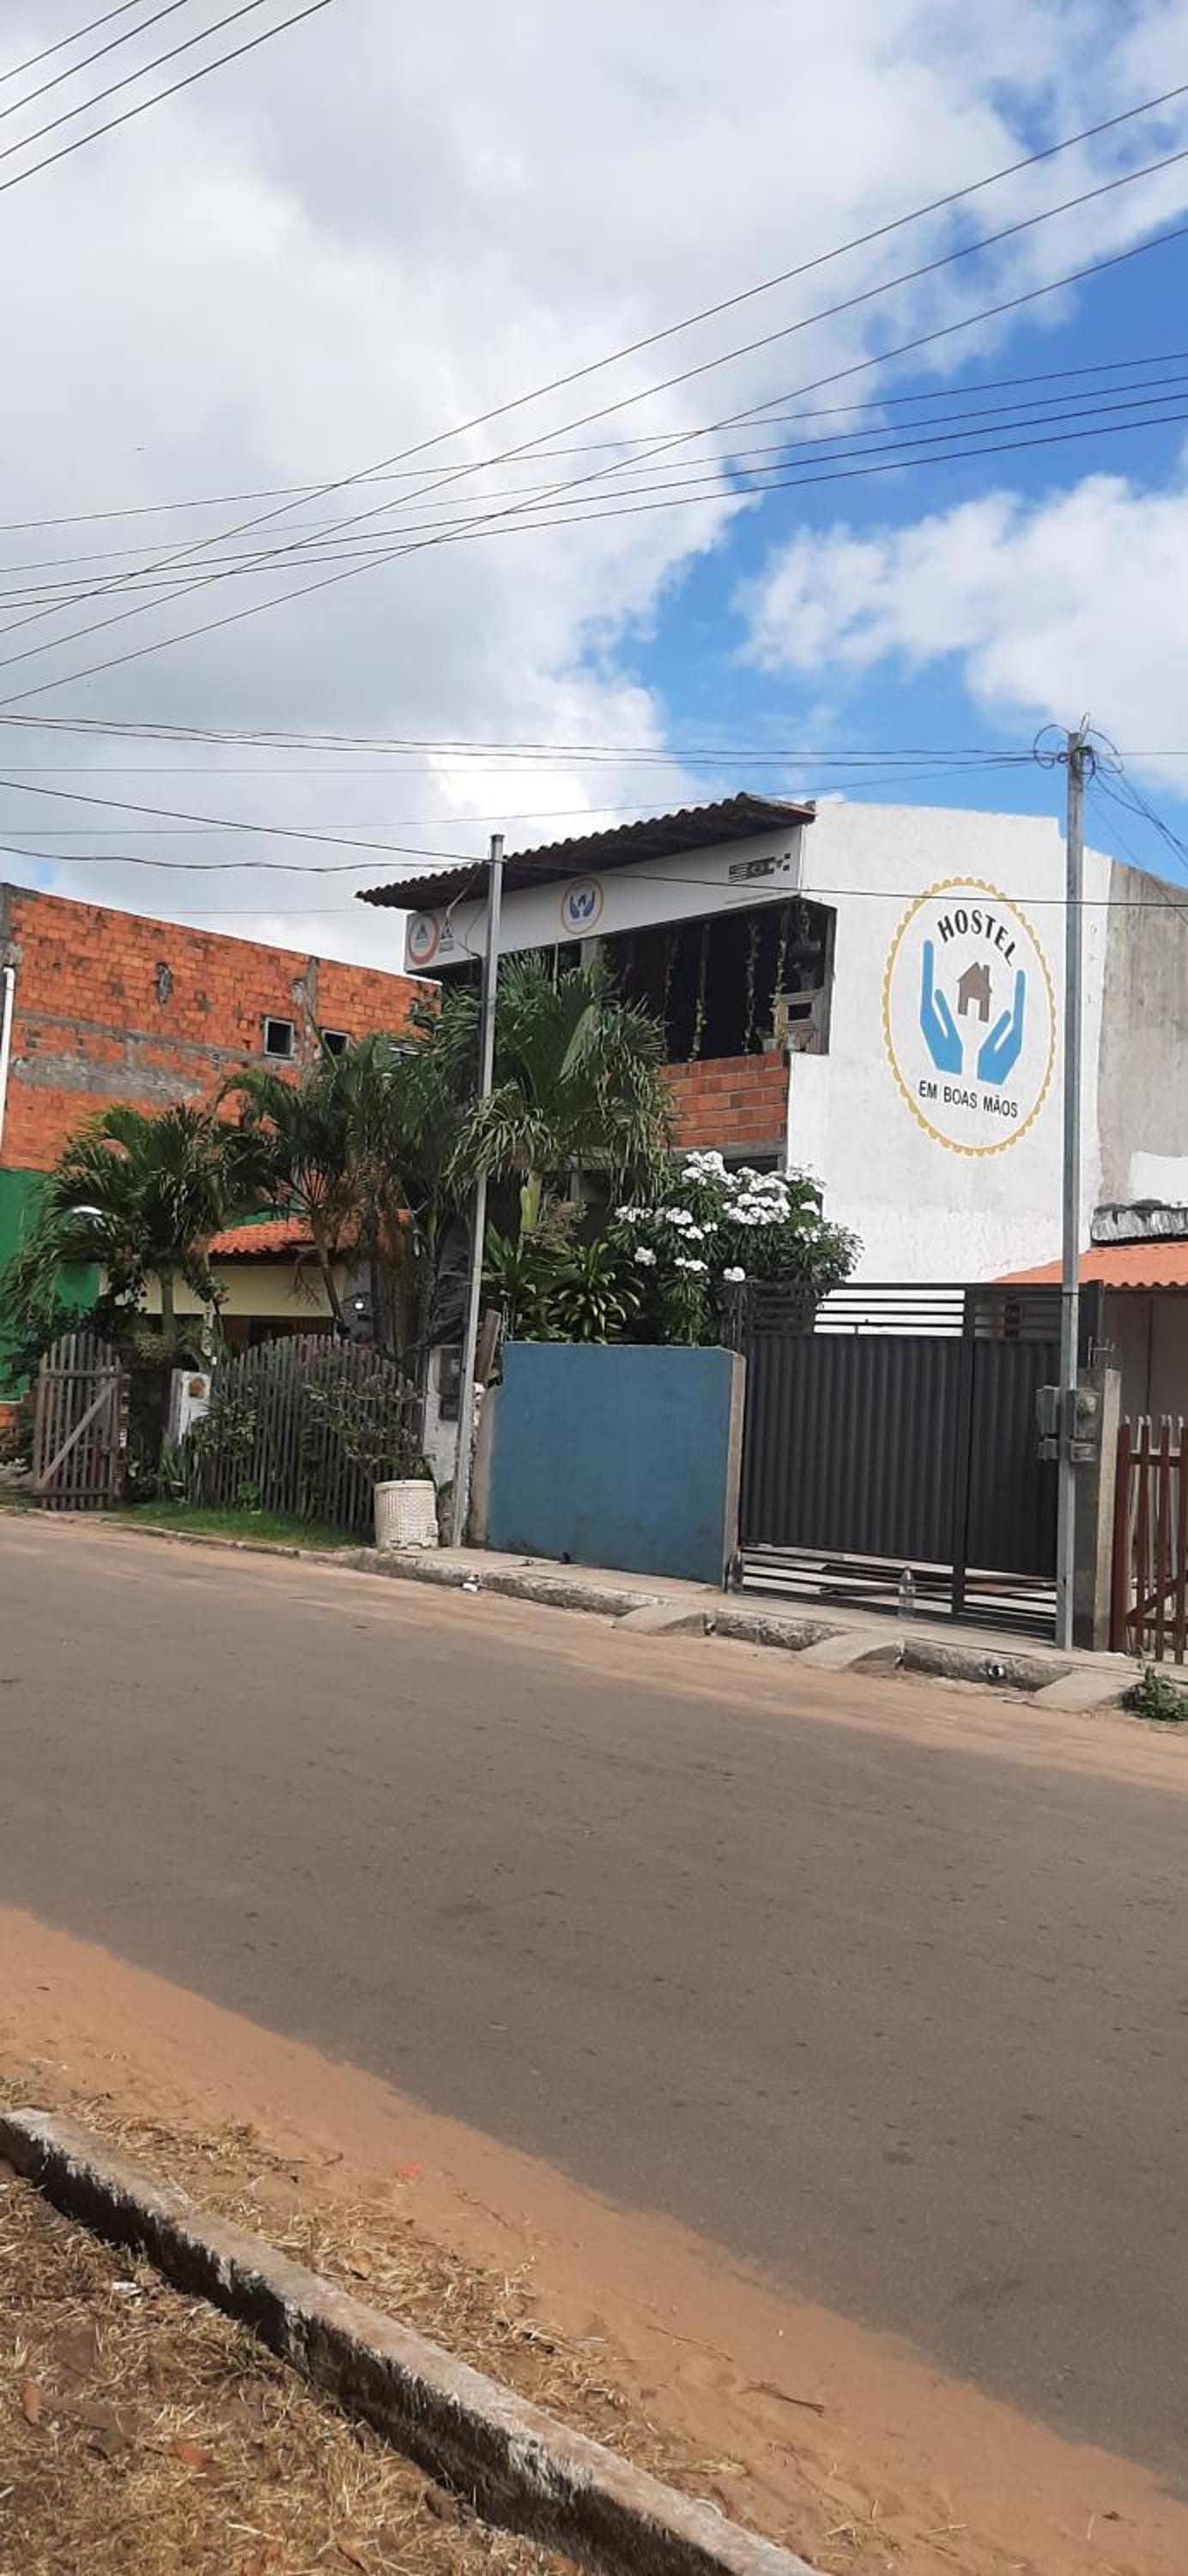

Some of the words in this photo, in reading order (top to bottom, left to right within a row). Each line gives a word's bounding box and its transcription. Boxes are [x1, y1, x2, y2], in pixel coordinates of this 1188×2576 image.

[936, 908, 1017, 967] HOSTEL
[918, 1079, 938, 1100] EM
[943, 1086, 978, 1109] BOAS
[983, 1094, 1018, 1118] MÃOS
